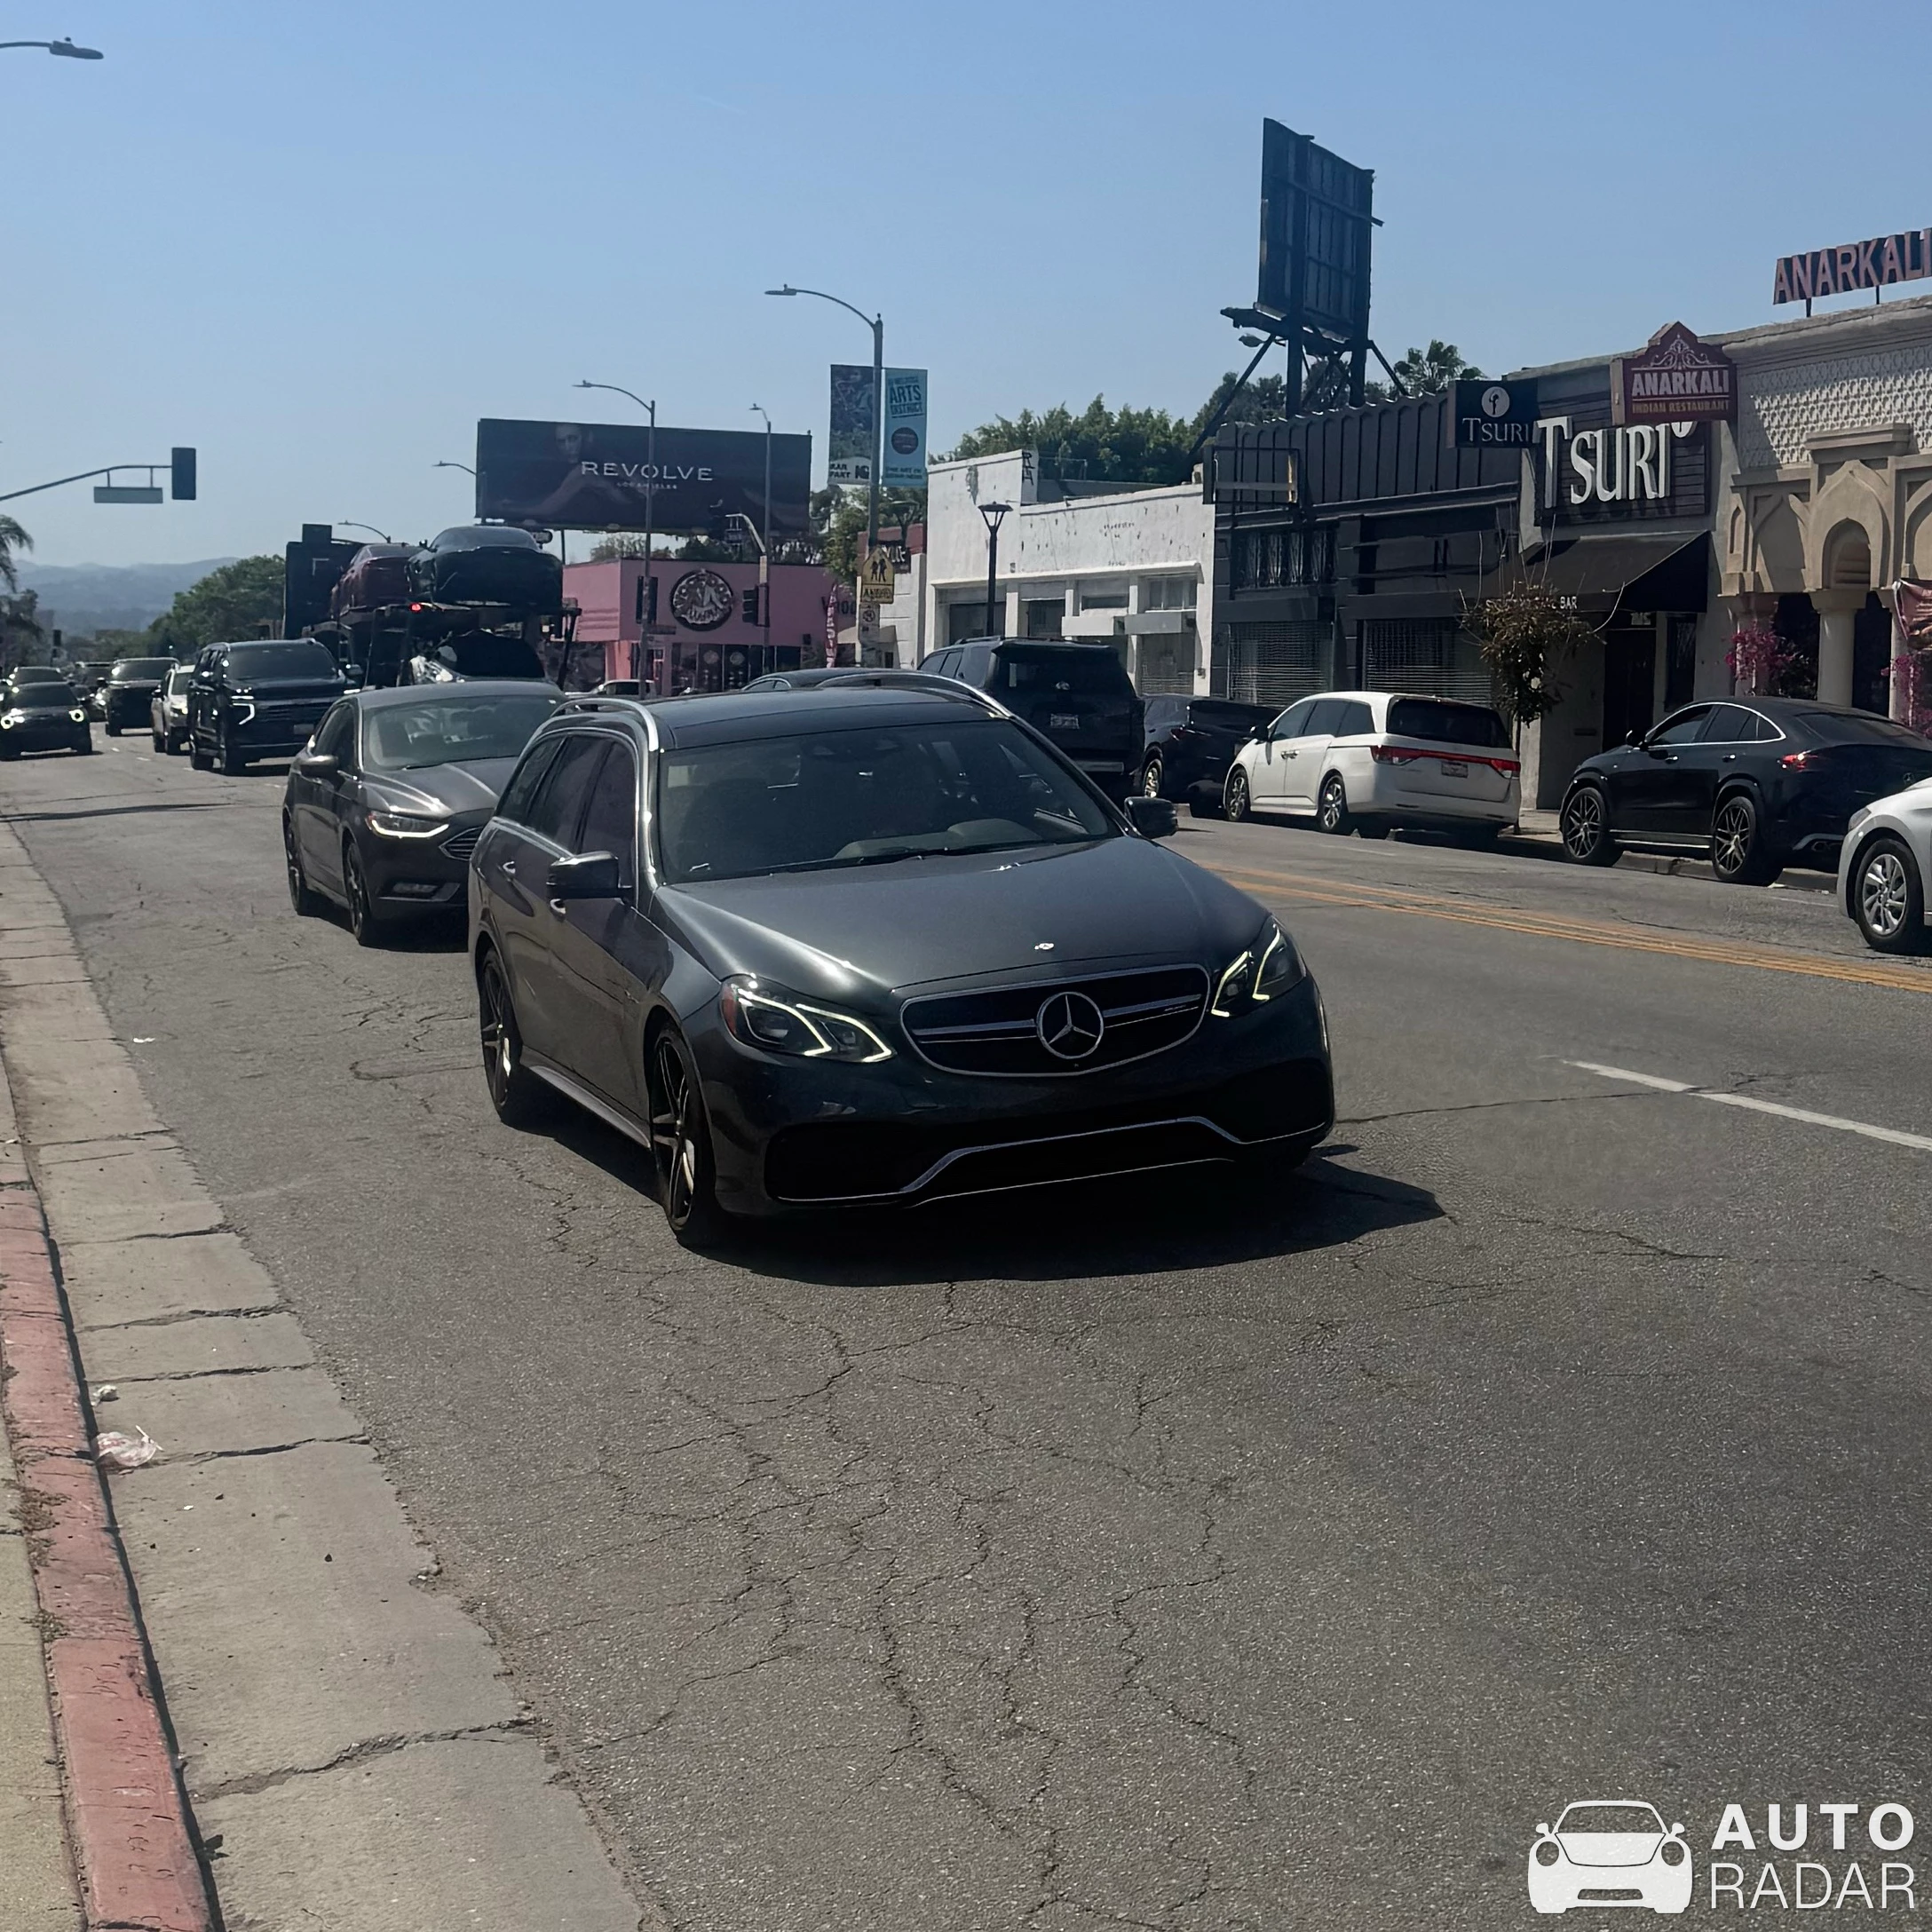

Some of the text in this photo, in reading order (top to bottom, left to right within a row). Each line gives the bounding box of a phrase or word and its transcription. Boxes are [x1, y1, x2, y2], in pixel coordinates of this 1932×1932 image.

[1632, 369, 1730, 397] ANARKALI
[890, 384, 922, 404] ARTS
[1633, 400, 1729, 414] INDIAN RESTAURANT
[1462, 417, 1529, 443] TSURI
[581, 461, 713, 481] REVOLVE
[1535, 416, 1671, 509] TSURI
[1560, 596, 1578, 609] BAR
